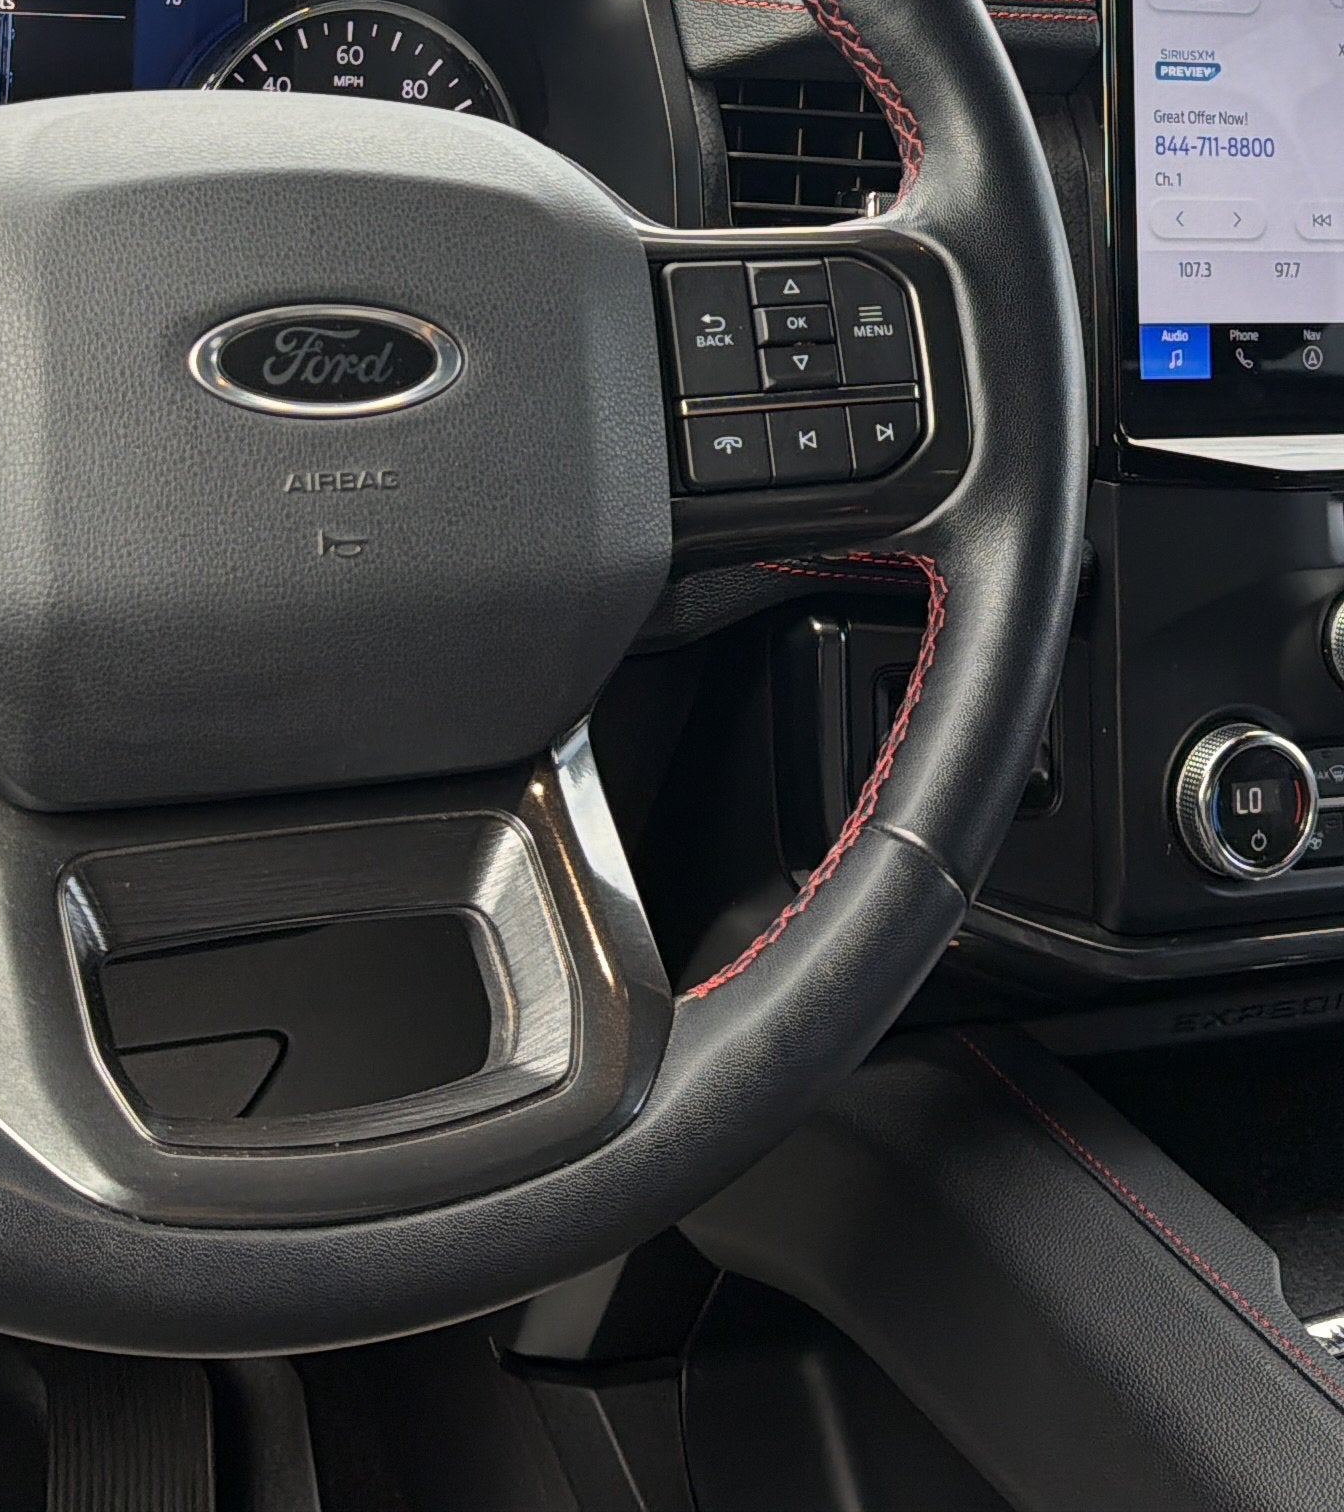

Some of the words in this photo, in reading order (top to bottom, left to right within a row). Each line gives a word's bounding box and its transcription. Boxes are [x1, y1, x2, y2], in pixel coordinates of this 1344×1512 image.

[336, 45, 364, 66] 60
[1160, 49, 1215, 61] SIRIUSXM
[1160, 66, 1214, 78] PREVIEW
[263, 76, 292, 93] 40
[333, 75, 364, 87] MPH
[402, 79, 428, 100] 80
[1154, 109, 1185, 125] Great
[1188, 110, 1216, 125] Offer
[1218, 111, 1248, 126] Now!
[1155, 136, 1275, 158] 844-711-8800
[1155, 172, 1173, 187] Ch.
[1176, 173, 1182, 186] 1
[1178, 262, 1212, 278] 107.3
[1274, 262, 1301, 278] 97.7
[786, 316, 808, 330] OK
[853, 325, 893, 337] MENU
[1161, 330, 1188, 342] Audio
[1229, 330, 1259, 342] Phone
[1303, 329, 1321, 341] Nav
[696, 334, 734, 348] BACK
[262, 326, 394, 385] Ford
[283, 469, 400, 493] AIRBAG
[1236, 787, 1262, 815] LO
